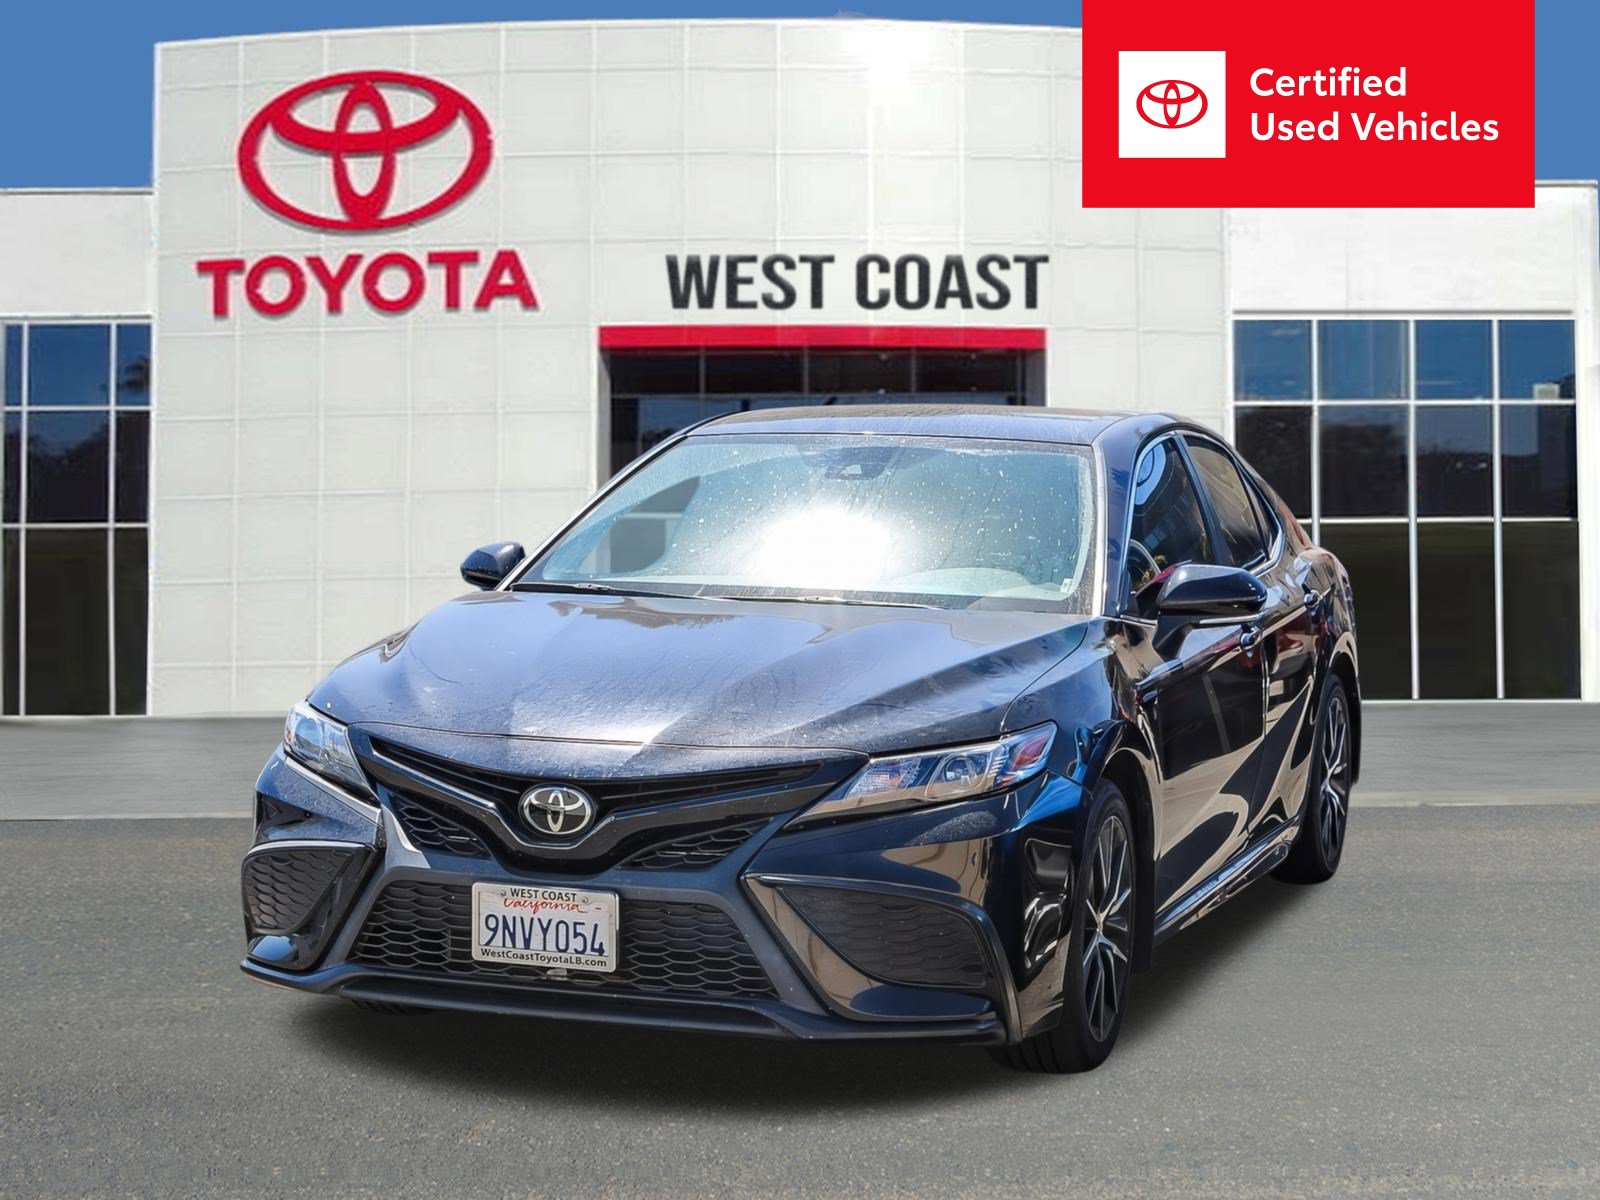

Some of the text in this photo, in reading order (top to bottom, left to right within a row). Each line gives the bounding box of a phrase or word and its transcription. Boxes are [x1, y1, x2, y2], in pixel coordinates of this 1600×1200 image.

[196, 249, 539, 319] TOYOTA
[666, 253, 1049, 310] WEST COAST
[510, 888, 577, 902] WEST COAST
[484, 913, 606, 956] 9NVY054
[480, 947, 607, 968] WestCoastToyotaLB.com
